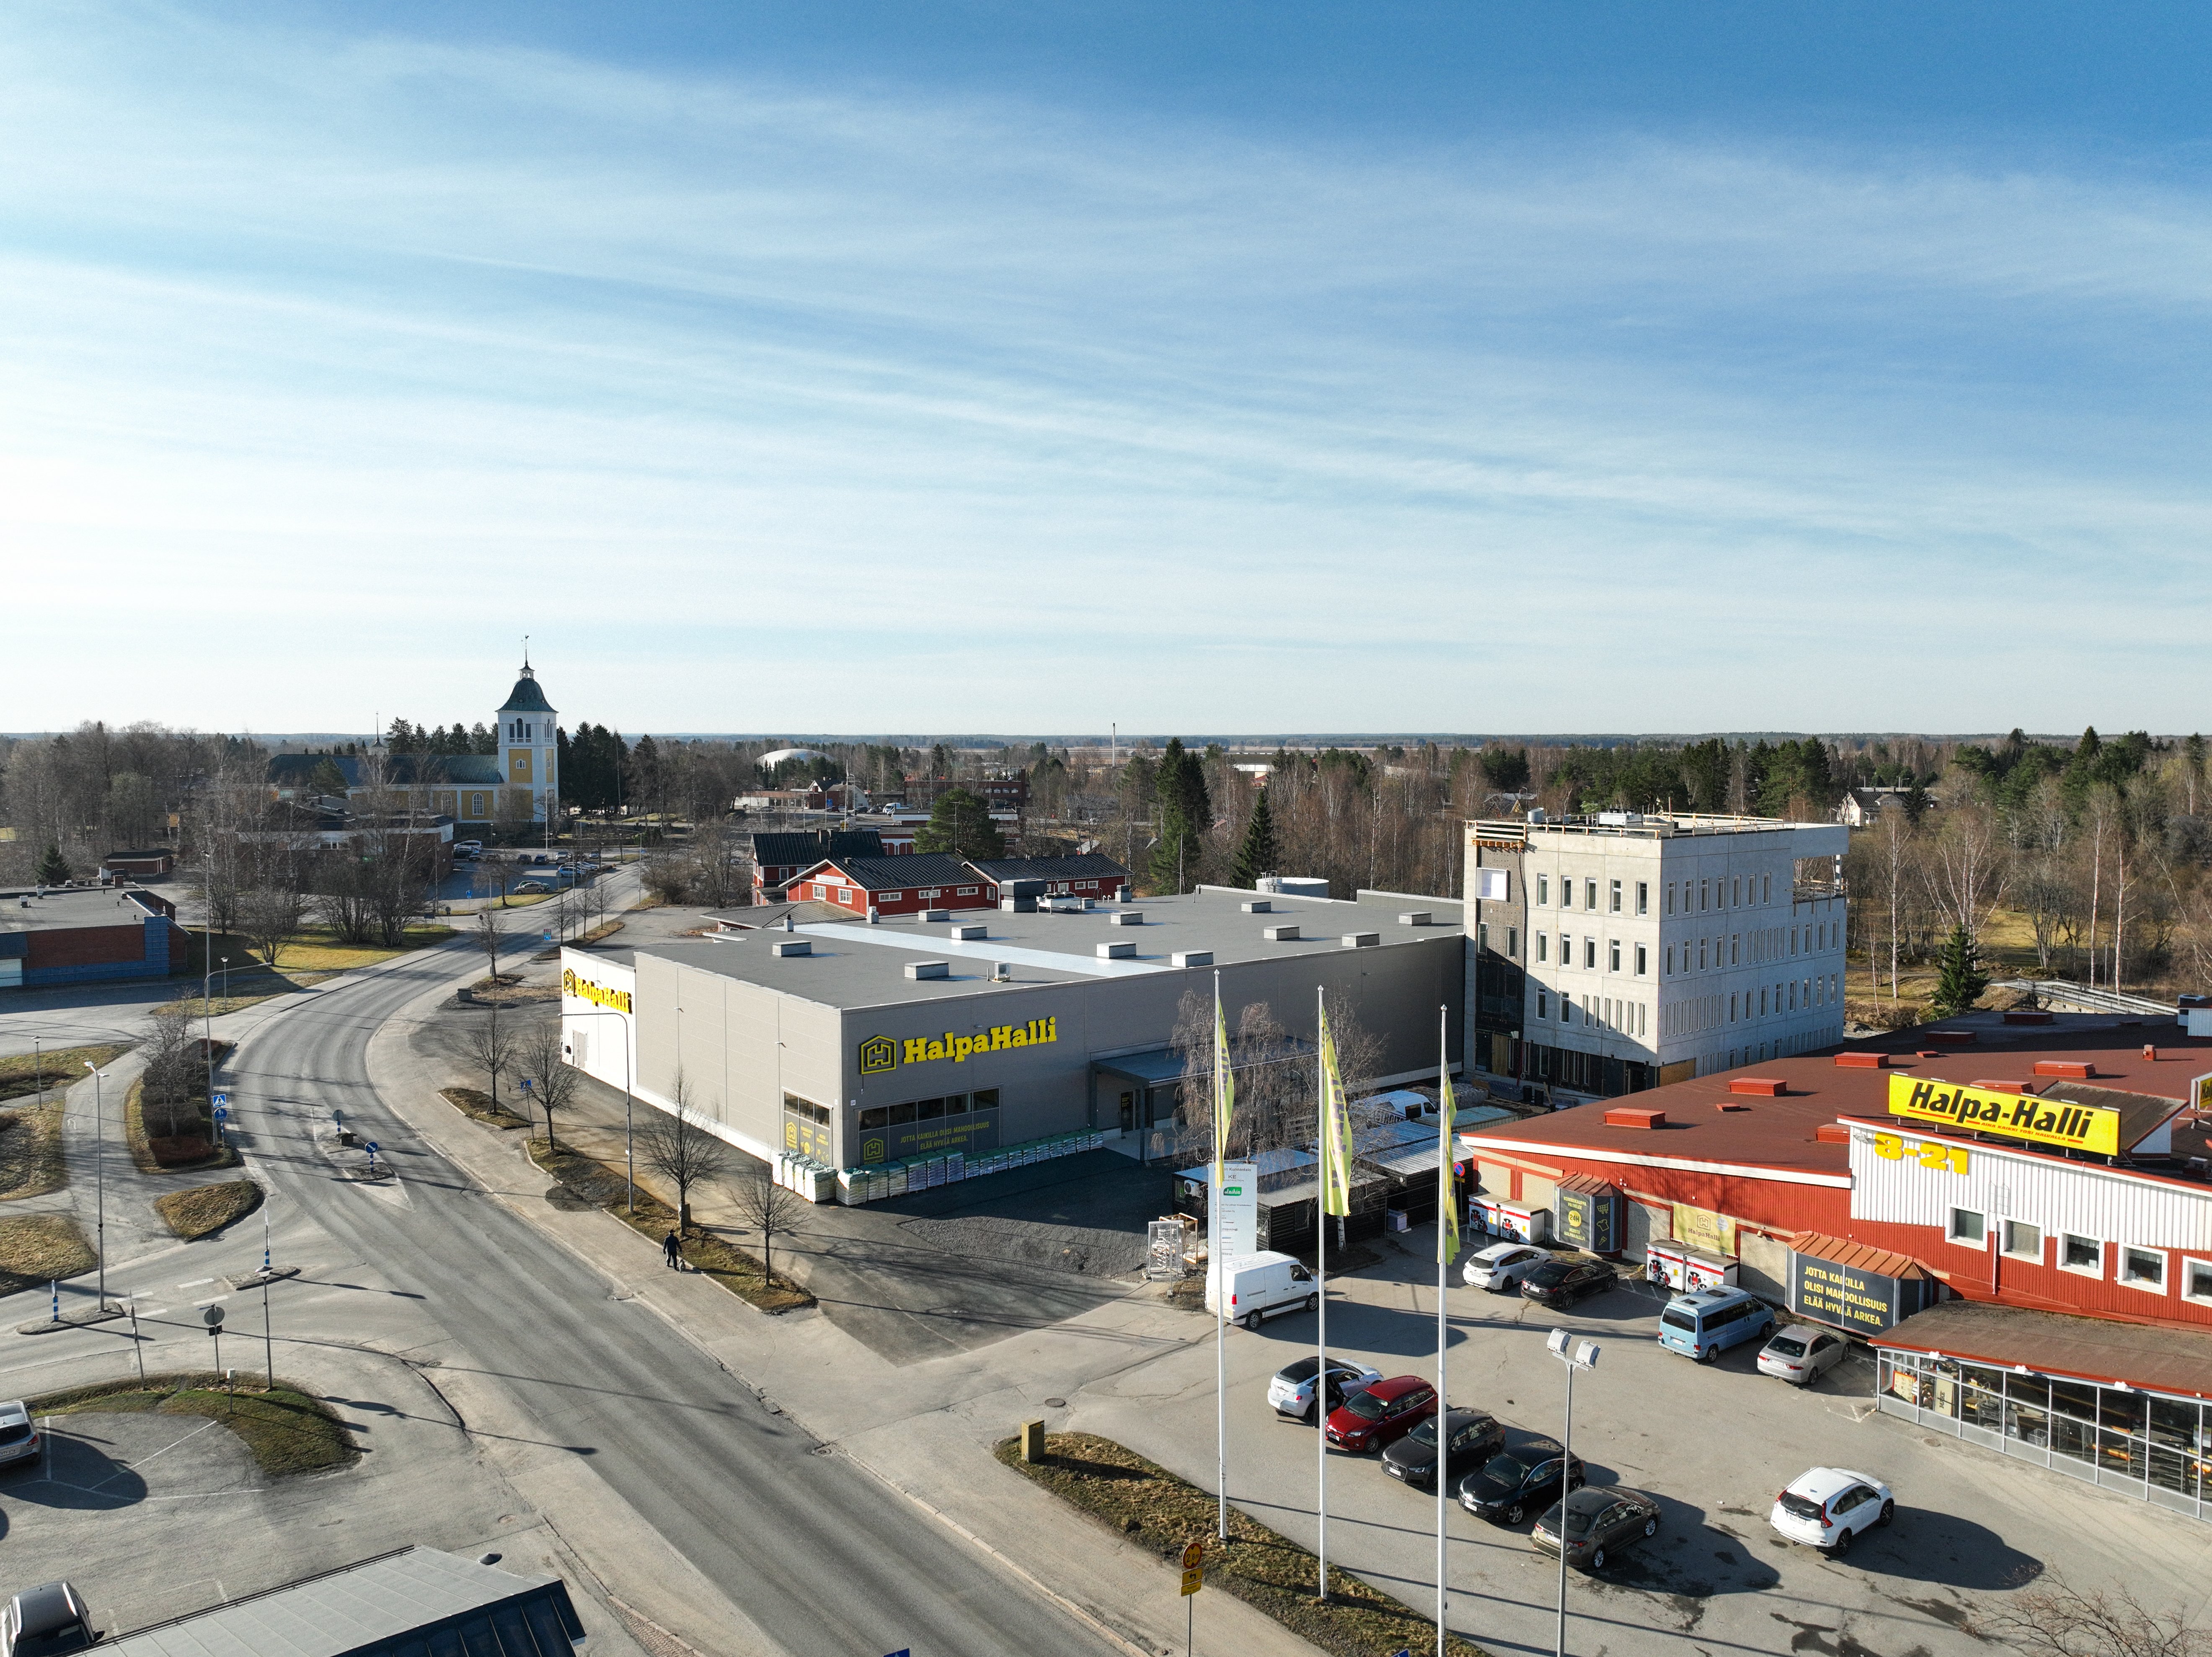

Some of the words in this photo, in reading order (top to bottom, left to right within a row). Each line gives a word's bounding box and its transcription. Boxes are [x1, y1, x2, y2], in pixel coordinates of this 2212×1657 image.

[574, 976, 629, 1014] HalpaHalli
[903, 1016, 1057, 1064] HalpaHalli
[1909, 1082, 2094, 1138] Halpa-Halli
[917, 1130, 938, 1141] KAIKILLA
[920, 1142, 932, 1150] ELÄÄ
[951, 1136, 968, 1144] ARKEA.
[2035, 1132, 2066, 1141] HALVALLA
[1874, 1131, 1968, 1175] 8-21
[1688, 1228, 1721, 1241] HalpaHalli
[1804, 1266, 1827, 1280] JOTTA
[1829, 1272, 1865, 1291] KAIKILLA
[1804, 1280, 1824, 1294] OLISI
[1826, 1286, 1887, 1312] MAHDOLLISUUS
[1804, 1295, 1823, 1309] ELÄÄ
[1854, 1310, 1883, 1327] ARKEA.
